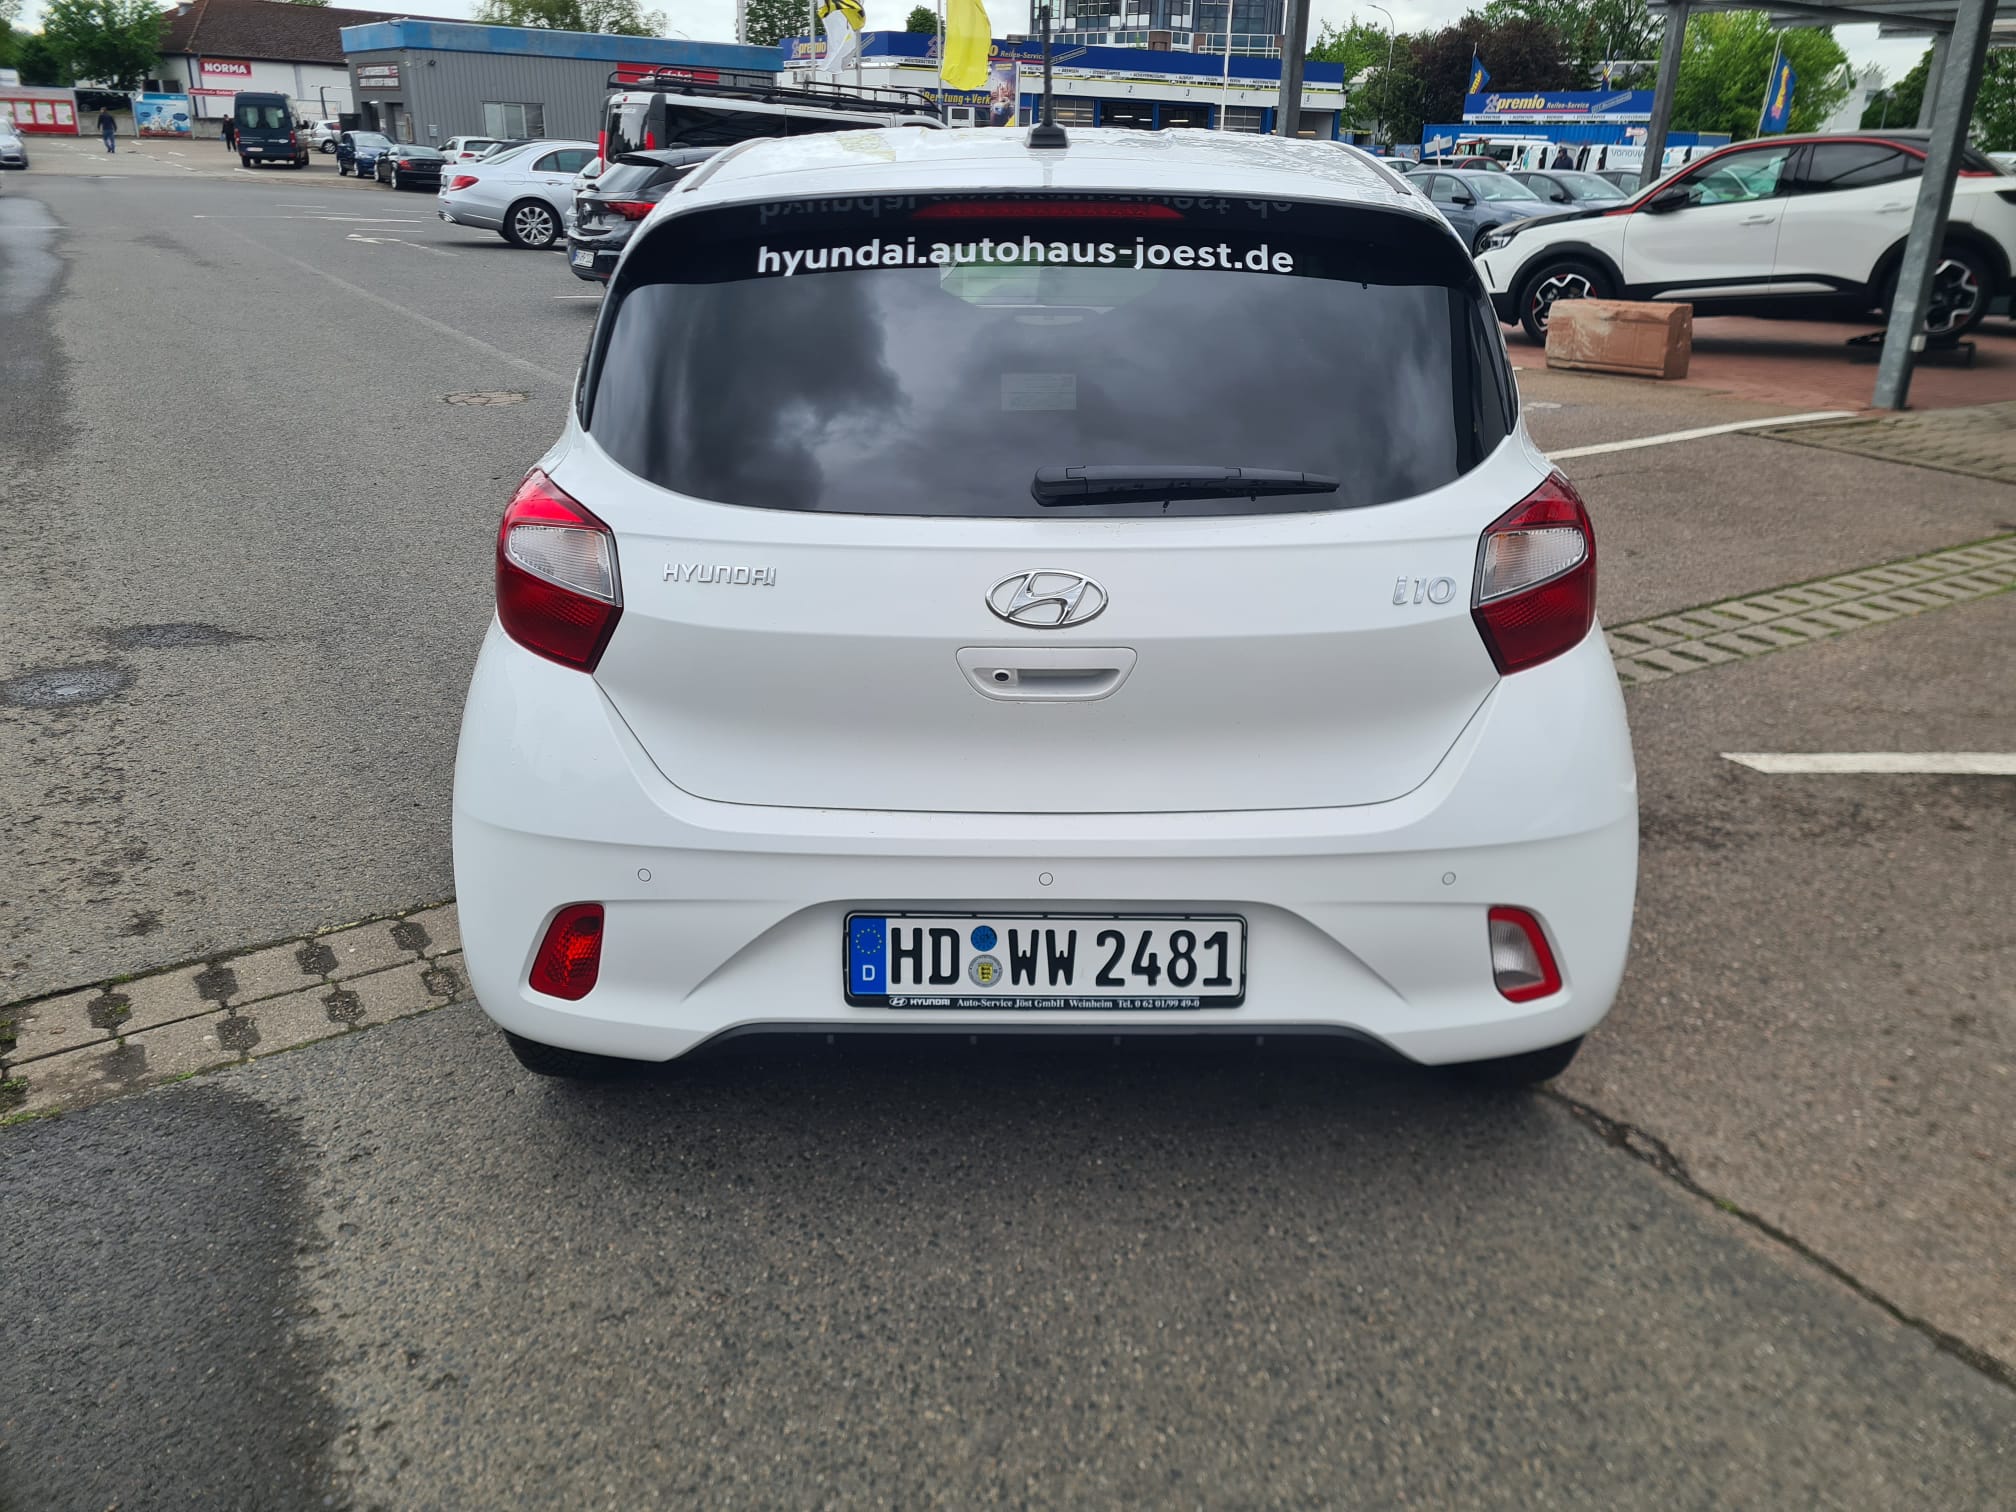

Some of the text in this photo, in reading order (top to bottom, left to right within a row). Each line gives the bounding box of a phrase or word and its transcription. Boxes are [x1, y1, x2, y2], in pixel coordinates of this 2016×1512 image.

[204, 63, 248, 73] NORMA
[1495, 94, 1546, 113] premio
[758, 235, 1294, 276] hyundai.autohaus-joest.de
[663, 563, 777, 586] HYUNDAI
[1392, 576, 1457, 606] i10
[891, 927, 1233, 988] HD WW 2481
[862, 964, 876, 981] D
[910, 998, 950, 1006] HYUNDAI
[957, 999, 1013, 1008] Auto-Service
[1015, 998, 1033, 1008] Jöst
[1034, 999, 1064, 1008] GmbH
[1069, 999, 1113, 1009] Weinheim
[1118, 999, 1133, 1009] Tel.
